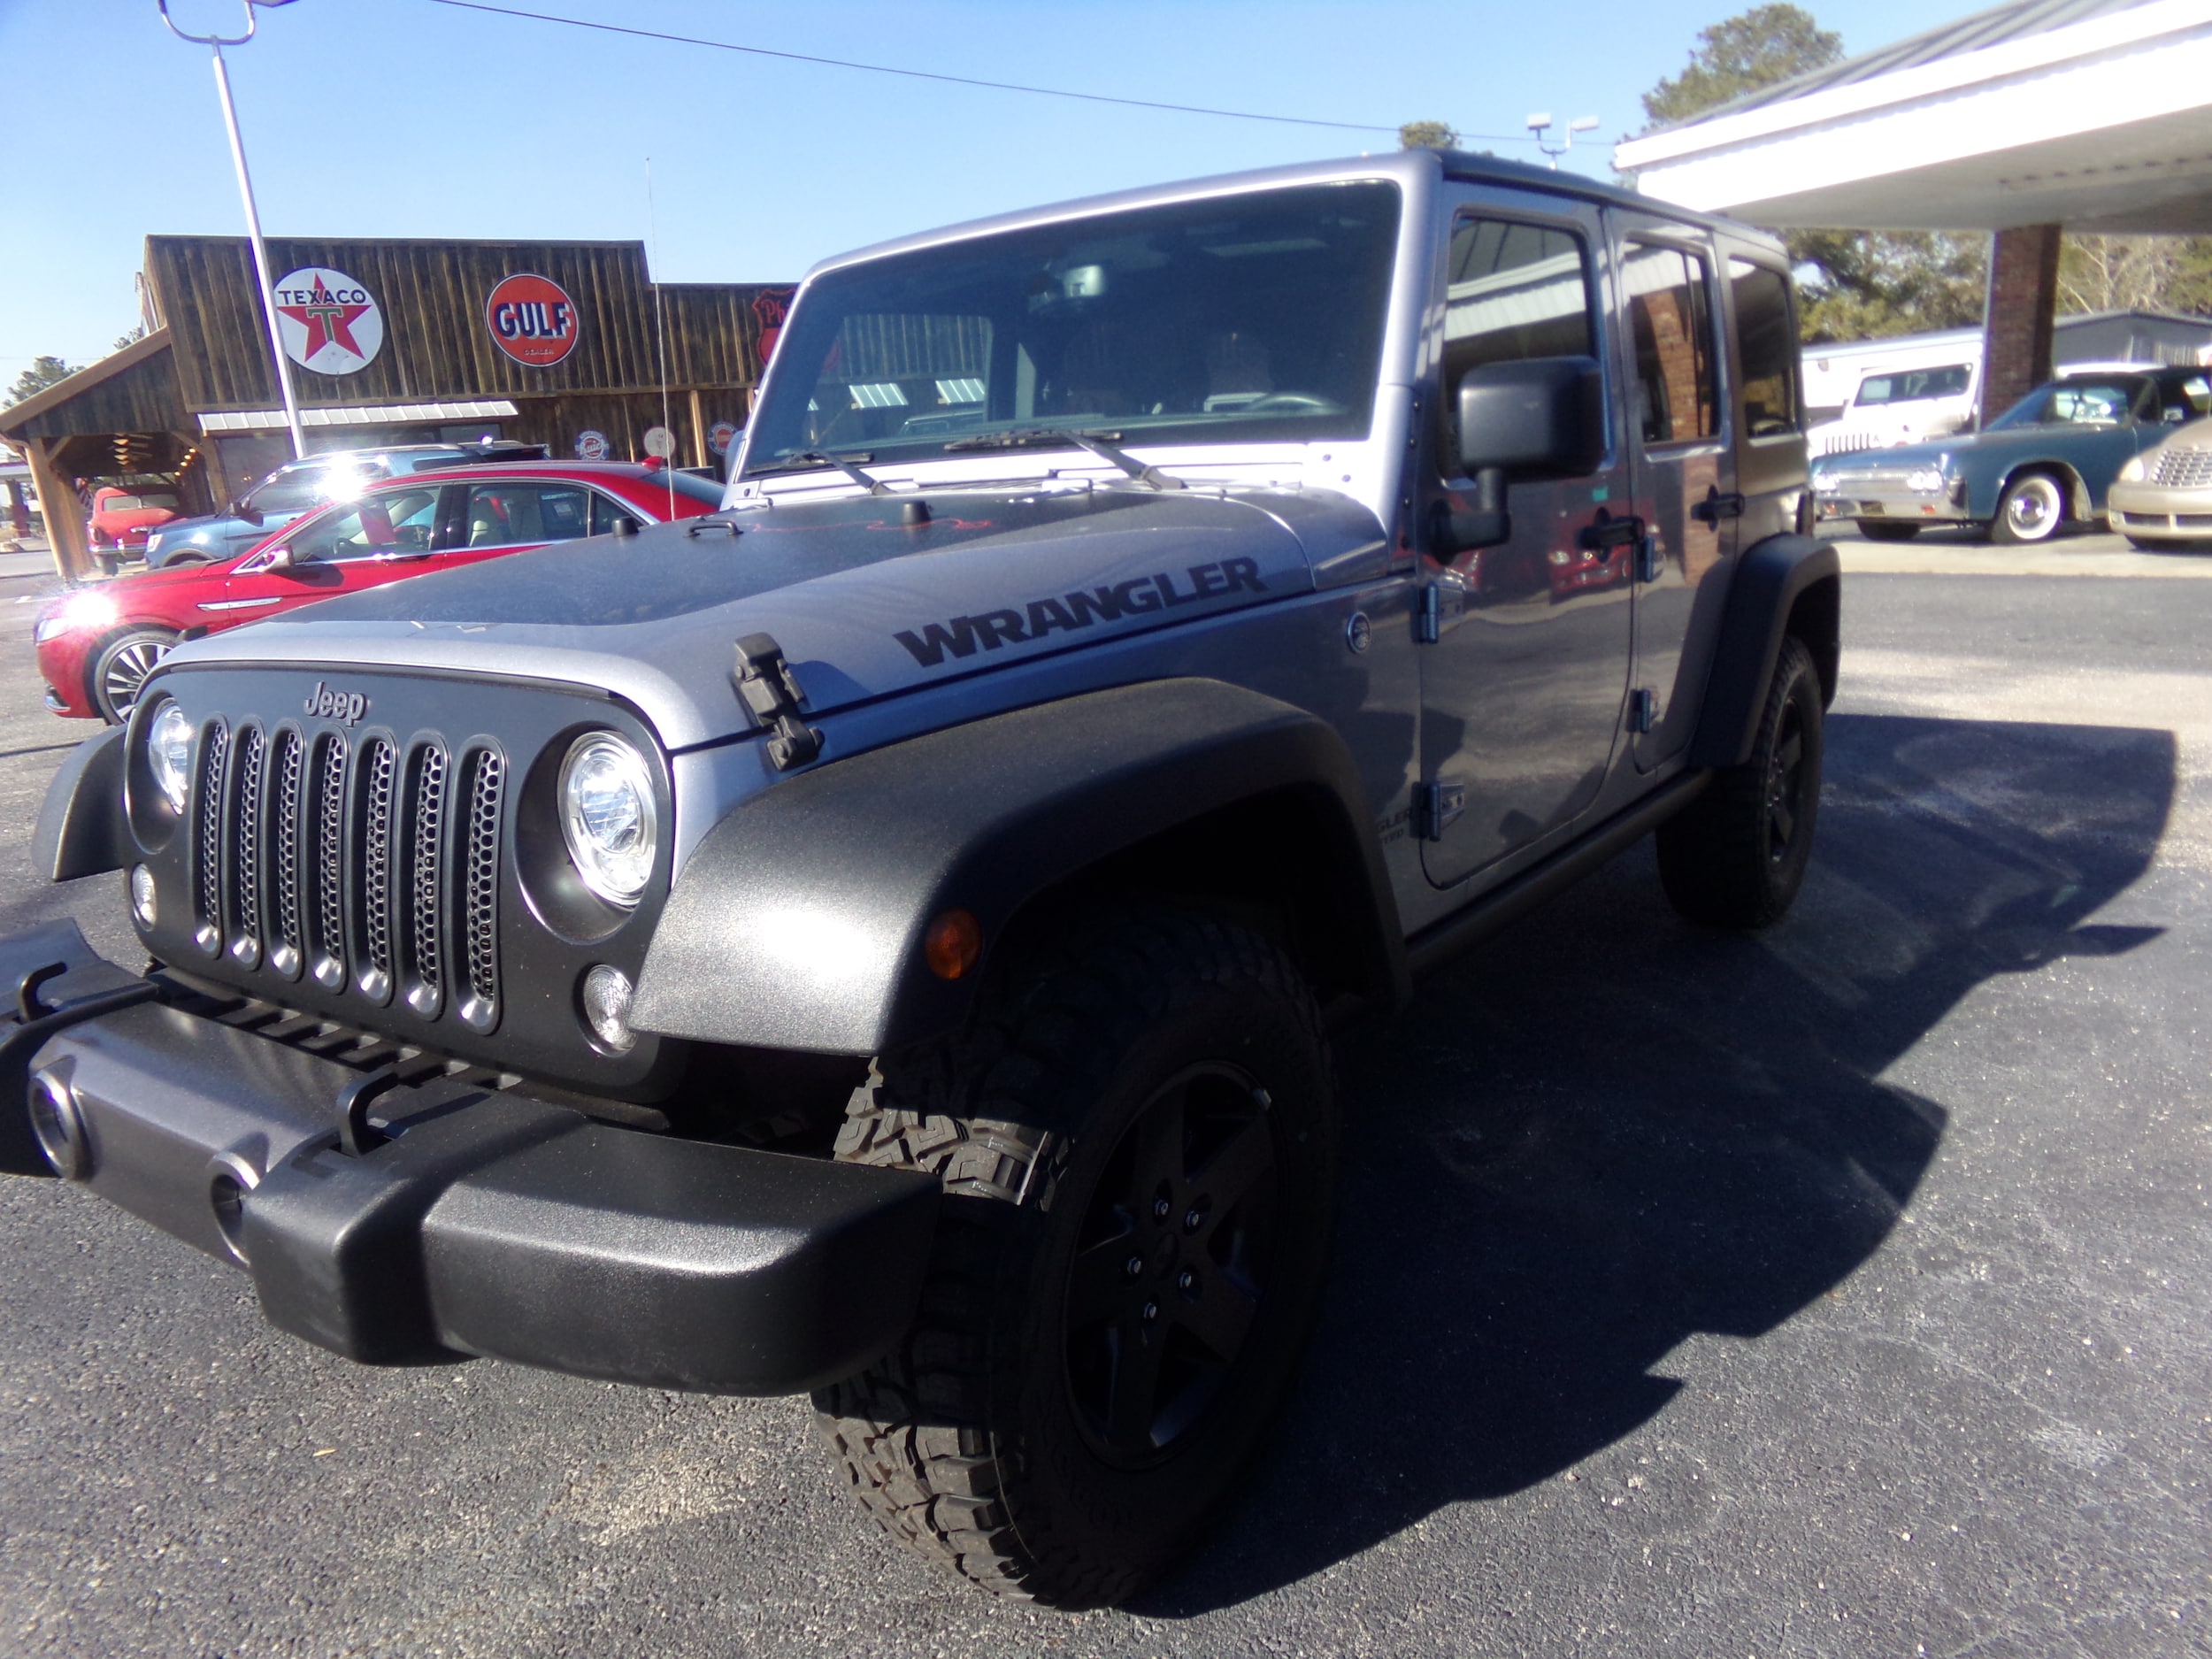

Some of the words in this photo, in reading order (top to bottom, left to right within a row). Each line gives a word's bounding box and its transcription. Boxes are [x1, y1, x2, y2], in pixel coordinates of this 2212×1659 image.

[278, 289, 367, 305] TEXACO
[305, 306, 343, 342] T
[495, 302, 572, 341] GULF
[893, 556, 1270, 668] WRANGLER
[303, 680, 367, 728] Jeep
